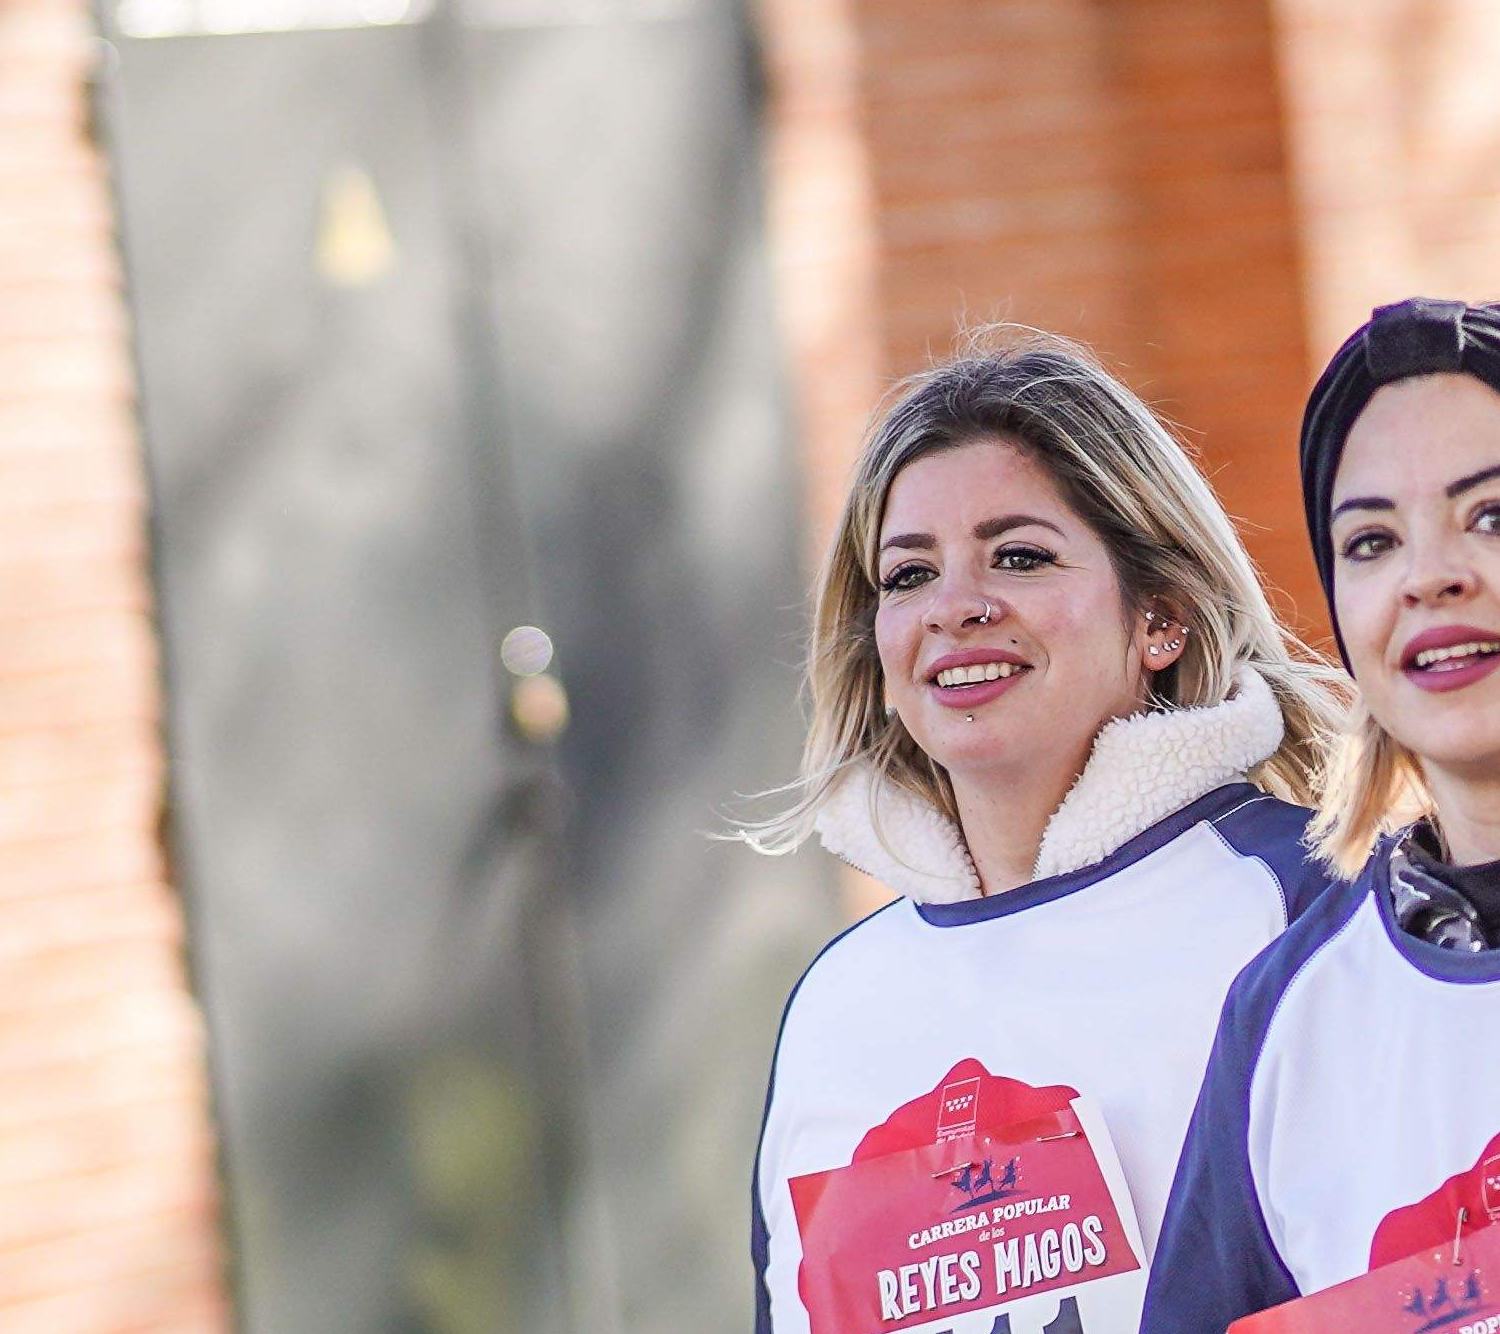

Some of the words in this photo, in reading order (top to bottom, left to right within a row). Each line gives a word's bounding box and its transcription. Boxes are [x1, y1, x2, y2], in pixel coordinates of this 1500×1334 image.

[908, 1211, 990, 1250] CARRERA
[992, 1194, 1071, 1226] POPULAR
[978, 1230, 990, 1242] de
[991, 1227, 1005, 1239] los
[877, 1250, 981, 1321] REYES
[994, 1215, 1106, 1295] MAGOS
